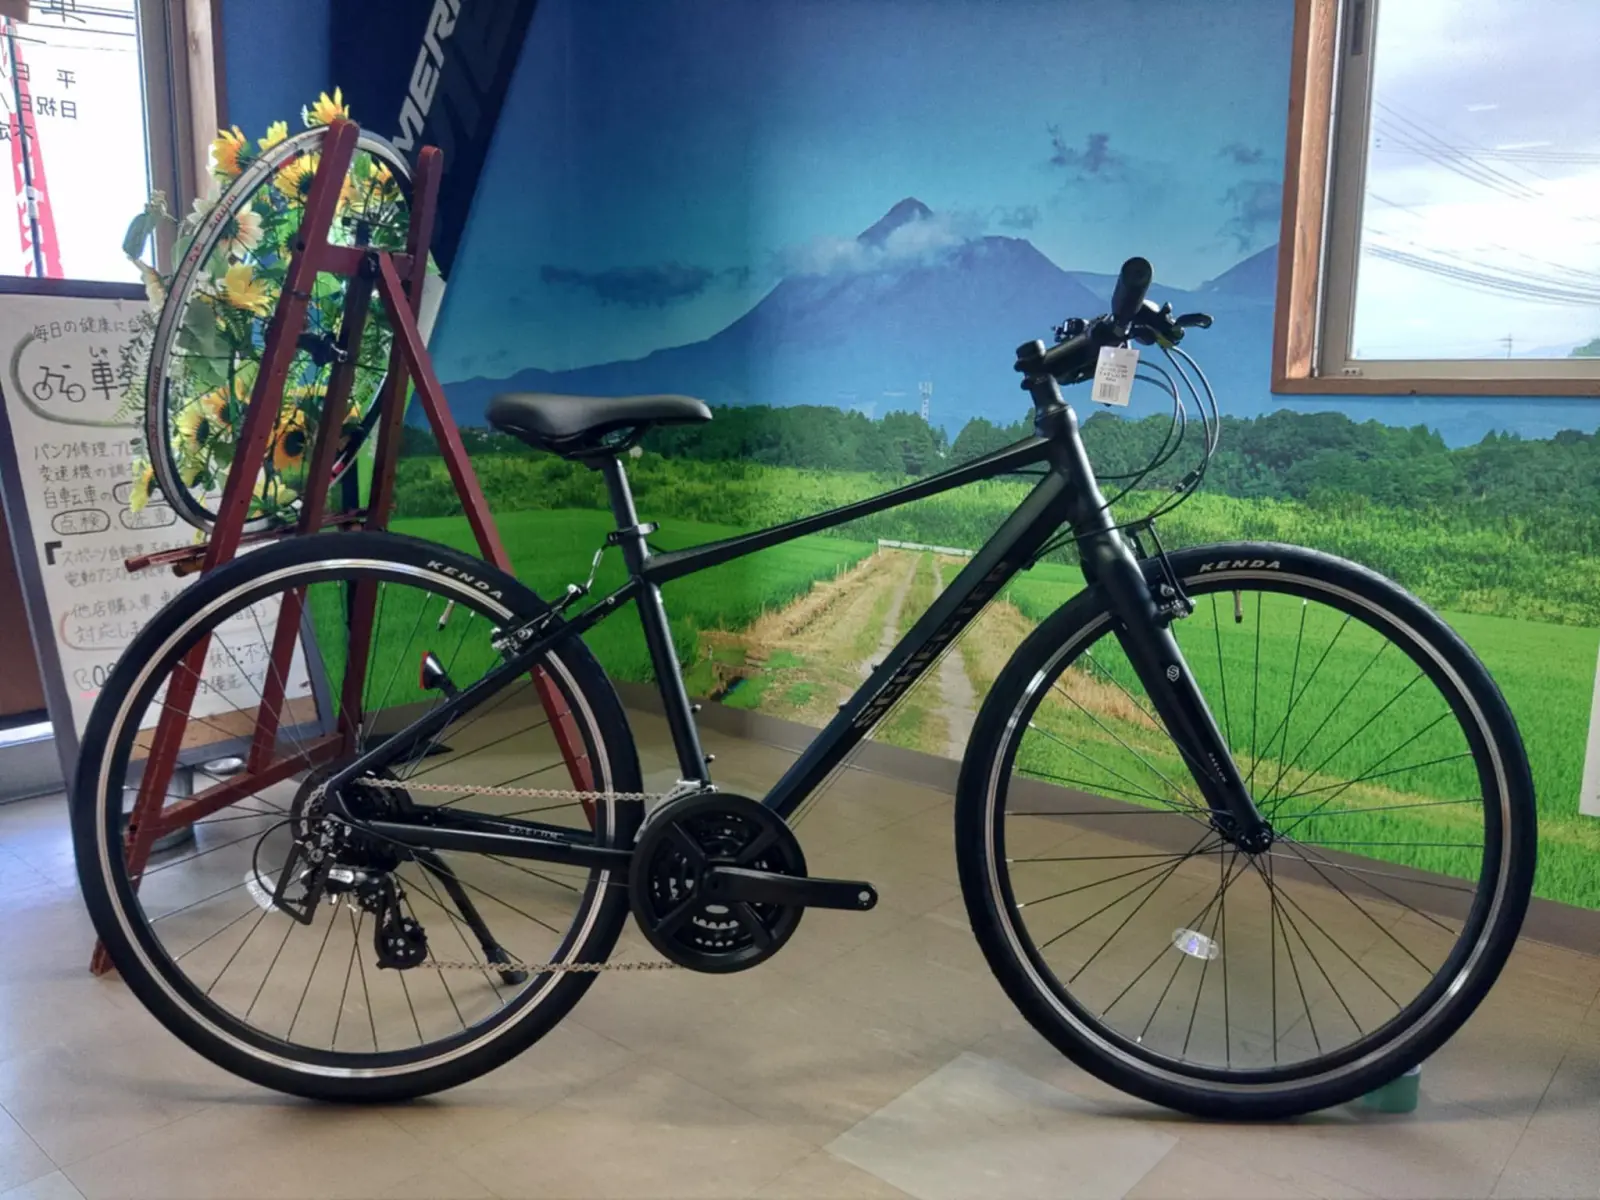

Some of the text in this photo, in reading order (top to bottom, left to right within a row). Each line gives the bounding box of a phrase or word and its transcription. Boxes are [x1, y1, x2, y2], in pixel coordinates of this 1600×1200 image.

[1200, 560, 1281, 573] KENDA
[427, 560, 503, 599] KENDA
[75, 621, 142, 643] 対応しま
